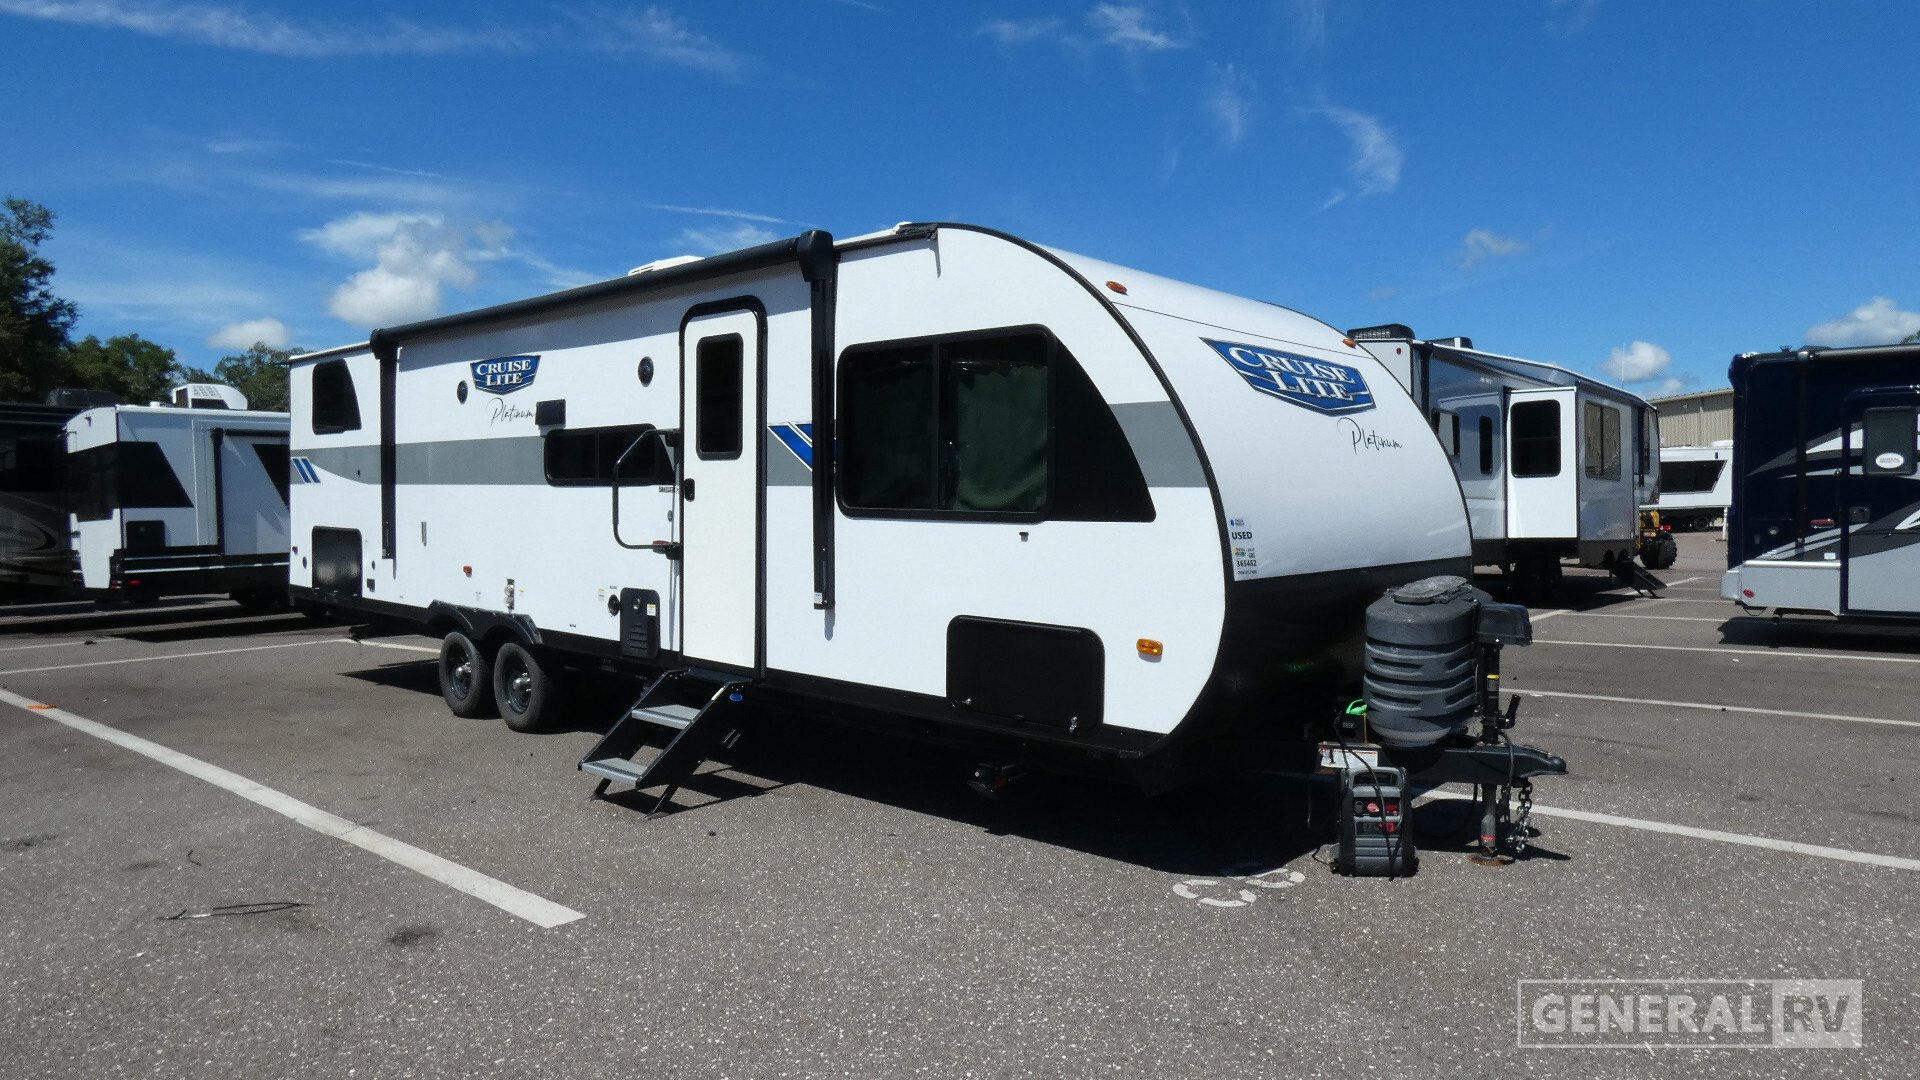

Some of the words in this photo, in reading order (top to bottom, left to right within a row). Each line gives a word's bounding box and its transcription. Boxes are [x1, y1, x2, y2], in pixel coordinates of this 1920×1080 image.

[477, 360, 531, 376] CRUISE
[486, 373, 522, 386] LITE
[1229, 346, 1356, 384] CRUISE
[1265, 370, 1354, 402] LITE
[486, 398, 534, 427] Platinum
[1337, 417, 1402, 454] Platinum
[1231, 531, 1252, 540] USED
